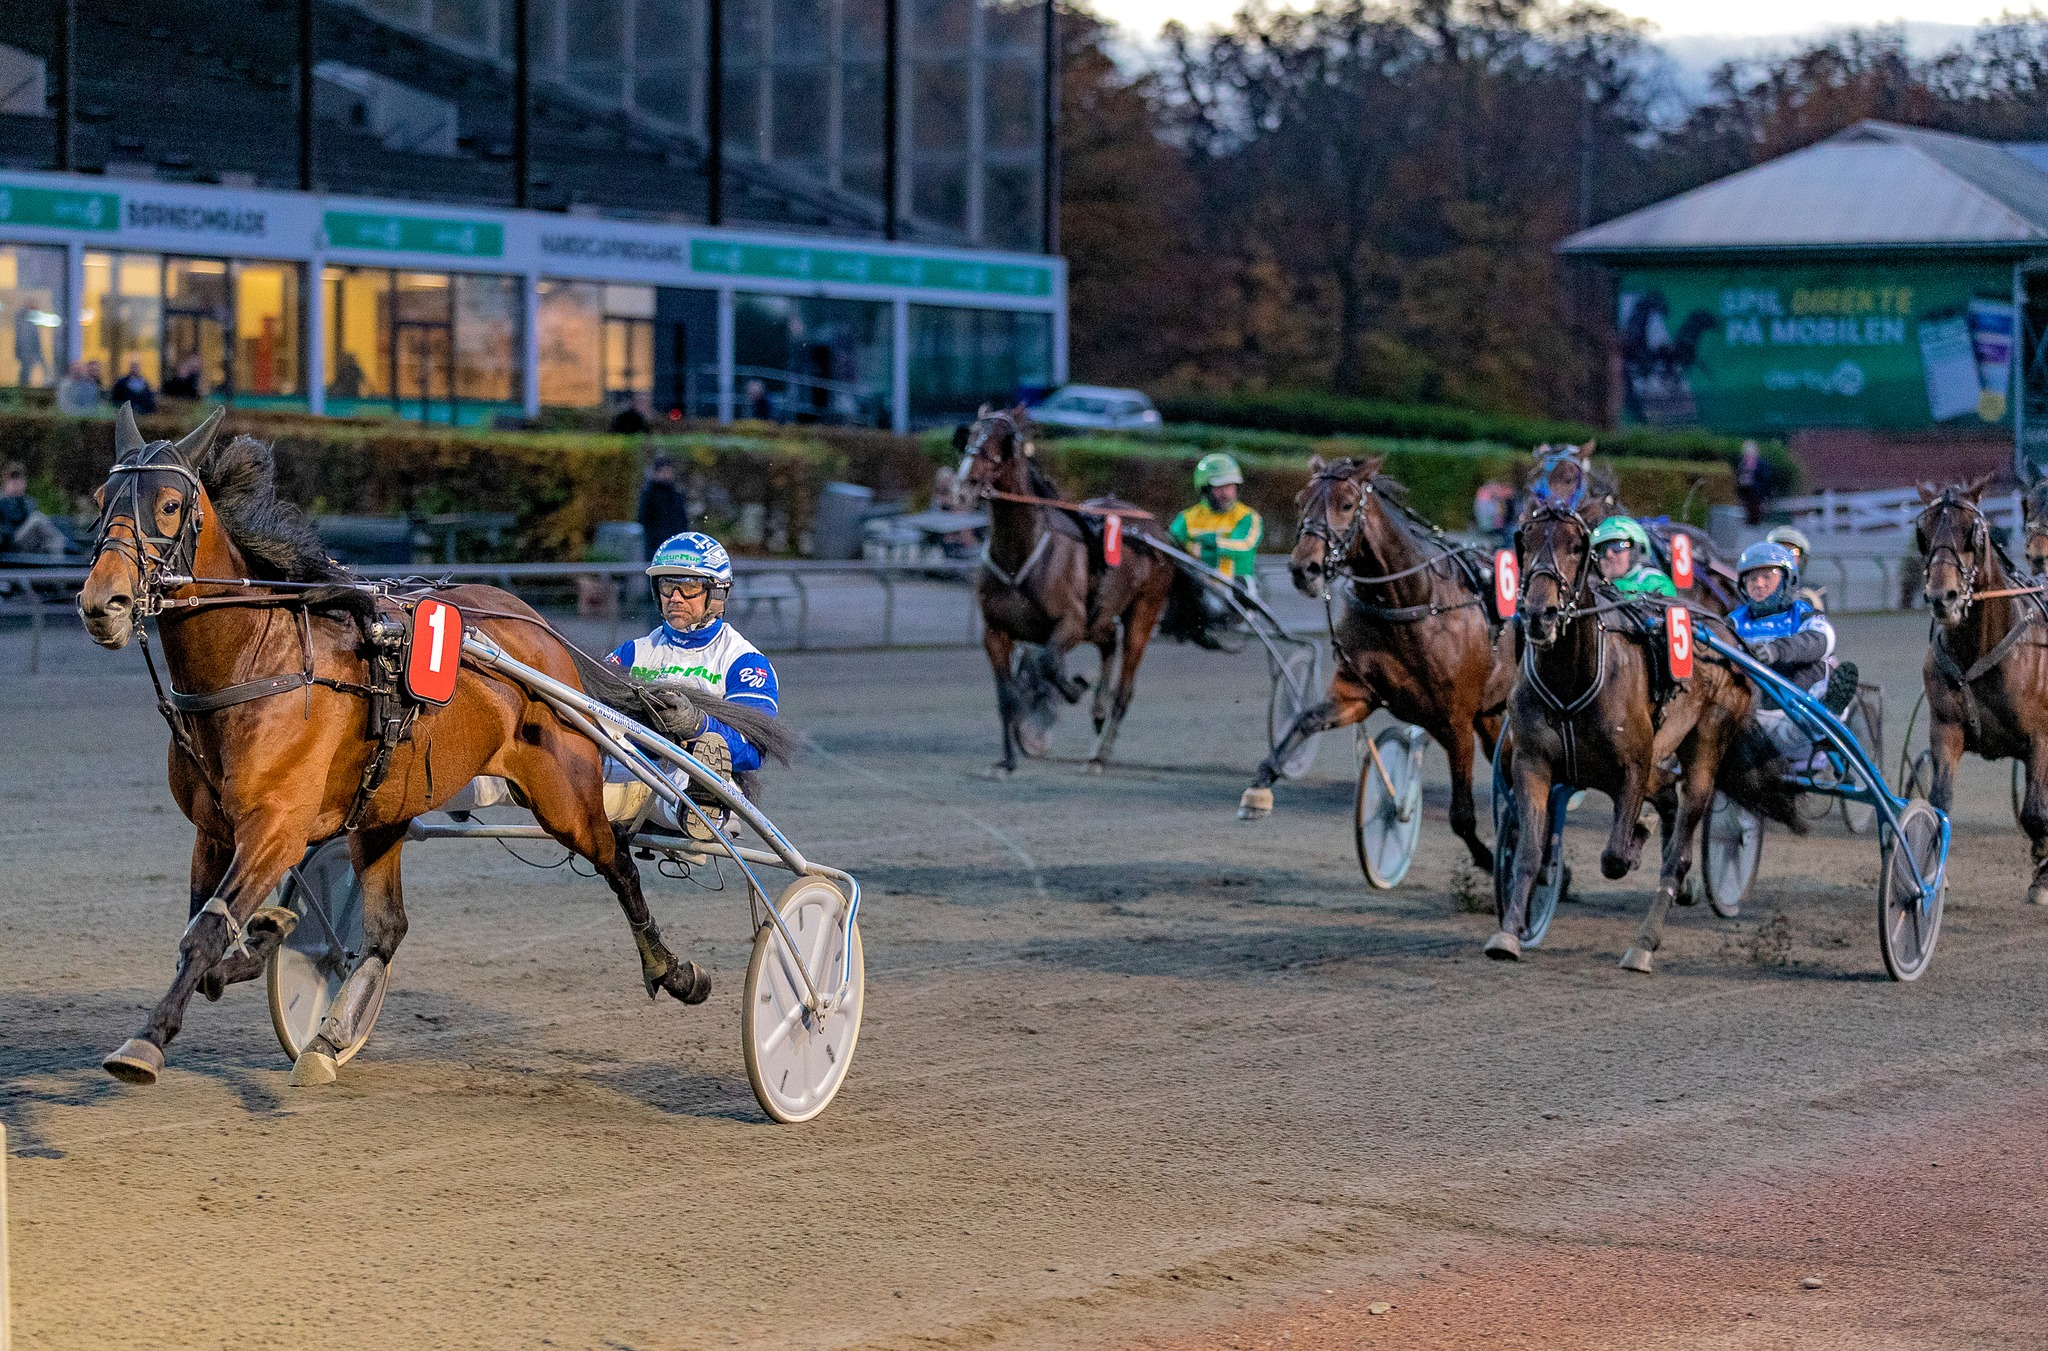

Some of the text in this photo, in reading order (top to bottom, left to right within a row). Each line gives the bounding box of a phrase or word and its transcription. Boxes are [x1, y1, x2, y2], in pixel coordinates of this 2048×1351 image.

[1720, 287, 1912, 315] SPIL DIREKTE
[1727, 316, 1905, 345] PÅ MOBILEN
[1499, 551, 1515, 601] 6
[1674, 536, 1690, 576] 3
[429, 604, 446, 673] 1
[1671, 608, 1689, 660] 5
[739, 667, 766, 688] BW
